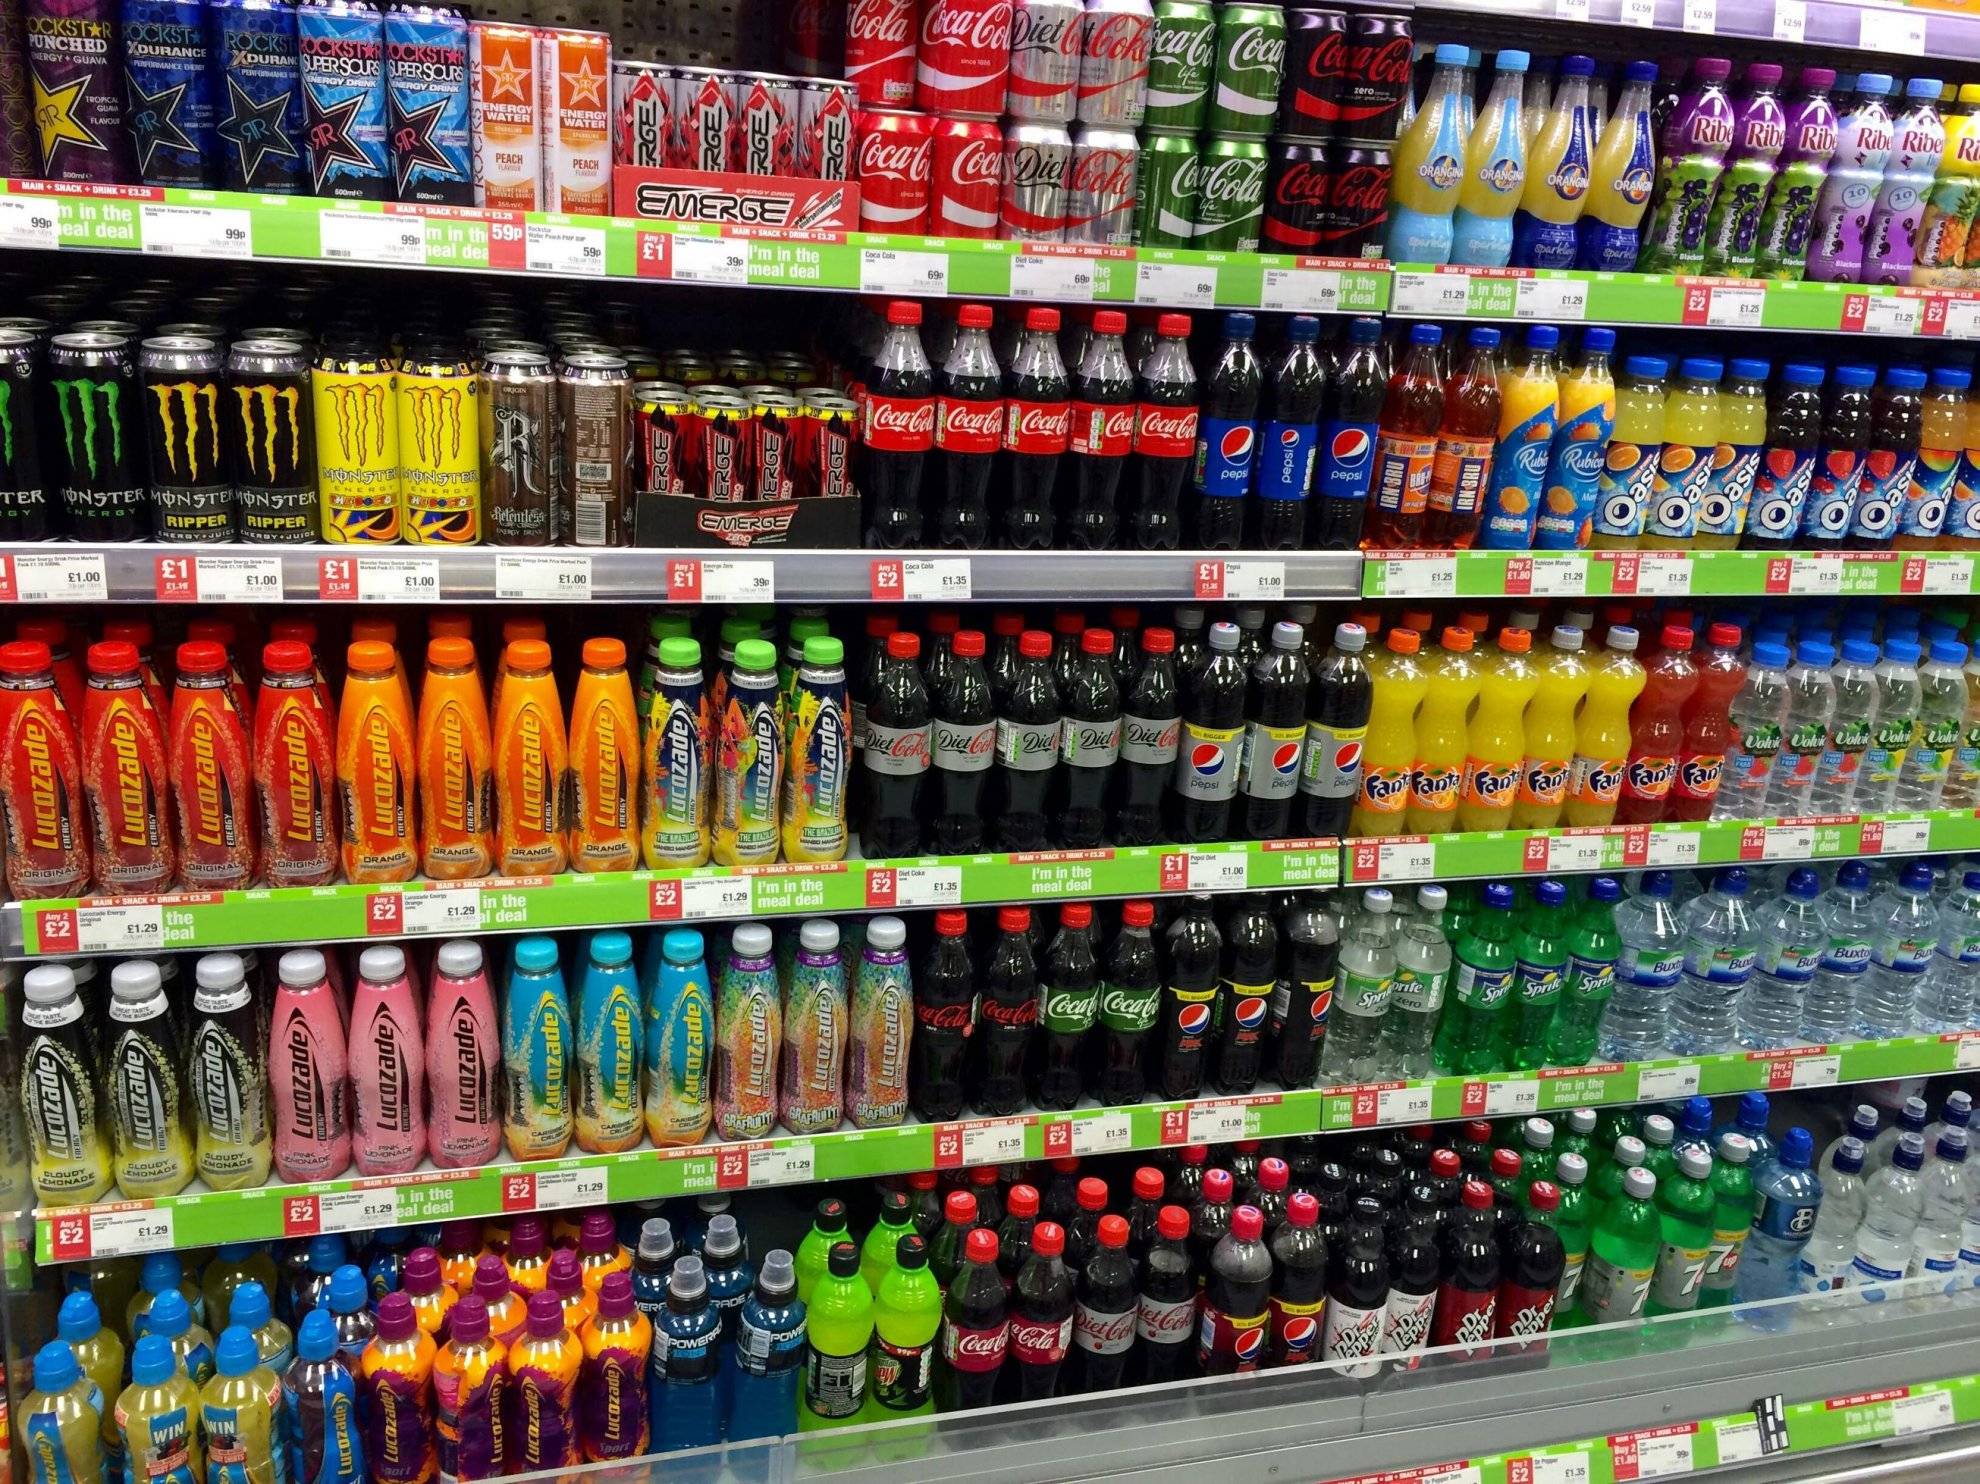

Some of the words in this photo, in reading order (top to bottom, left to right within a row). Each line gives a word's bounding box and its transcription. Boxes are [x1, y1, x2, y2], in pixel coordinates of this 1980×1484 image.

[483, 103, 531, 114] ENERGY
[560, 109, 607, 120] ENERGY
[487, 112, 530, 123] WATER
[564, 118, 606, 129] WATER
[495, 153, 523, 165] PEACH
[573, 159, 599, 170] PEACH
[636, 184, 795, 223] EMERGE
[77, 204, 96, 222] in
[101, 206, 132, 222] the
[31, 218, 52, 229] 99p
[85, 222, 134, 240] deal
[225, 228, 246, 240] 99p
[492, 223, 522, 242] 59p
[401, 234, 421, 246] 99p
[583, 248, 601, 259] 59p
[643, 243, 665, 261] £1
[749, 246, 769, 261] I'm
[773, 247, 790, 262] in
[794, 249, 820, 264] the
[726, 256, 744, 268] 39p
[749, 262, 788, 277] meal
[792, 264, 820, 279] deal
[928, 270, 943, 281] 69p
[1074, 274, 1089, 286] 69p
[1197, 283, 1212, 294] 69p
[1321, 288, 1336, 300] 69p
[1443, 290, 1464, 300] £1.29
[1350, 291, 1375, 305] deal
[1562, 296, 1583, 305] £1.29
[1689, 297, 1705, 311] £2
[1740, 303, 1759, 313] £1.25
[1847, 303, 1864, 318] £2
[1895, 313, 1913, 322] £1.25
[1281, 445, 1293, 483] pepsi
[166, 515, 227, 528] RIPPER
[247, 515, 307, 528] RIPPER
[160, 560, 188, 580] £1
[324, 560, 350, 580] £1
[1200, 564, 1218, 581] £1
[1432, 572, 1452, 581] £1.25
[1563, 572, 1583, 581] £1.29
[1617, 567, 1634, 581] £2
[1668, 572, 1688, 581] £1.35
[1771, 567, 1786, 581] £2
[1820, 572, 1838, 581] £1.35
[1862, 566, 1878, 578] the
[1951, 572, 1969, 581] £1.35
[68, 572, 100, 584] £1.00
[246, 576, 277, 587] £1.00
[405, 576, 435, 587] £1.00
[558, 574, 587, 585] £1.00
[674, 571, 694, 588] £1
[753, 577, 769, 588] 39p
[877, 572, 898, 588] £2
[942, 576, 967, 587] £1.35
[1259, 577, 1280, 587] £1.00
[1854, 579, 1876, 590] deal
[439, 714, 465, 832] Lucozade
[666, 718, 689, 823] Lucozade
[813, 715, 837, 819] Lucozade
[286, 720, 312, 843] Lucozade
[369, 713, 395, 837] Lucozade
[22, 721, 59, 850] Lucozade
[1191, 778, 1219, 790] pepsi
[1821, 829, 1840, 841] the
[511, 846, 554, 856] ORANGE
[1578, 848, 1598, 857] £1.35
[1628, 840, 1644, 855] £2
[1677, 844, 1695, 853] £1.35
[363, 852, 408, 864] ORANGE
[1165, 855, 1184, 871] £1
[1357, 854, 1374, 868] £2
[1410, 856, 1431, 866] £1.35
[1032, 867, 1049, 880] I'm
[1053, 866, 1069, 880] in
[1072, 864, 1092, 879] the
[1222, 866, 1244, 876] £1.00
[758, 881, 775, 894] I'm
[779, 880, 796, 892] in
[800, 879, 823, 892] the
[872, 877, 891, 894] £2
[933, 881, 957, 892] £1.35
[1032, 880, 1064, 894] meal
[1067, 878, 1092, 892] deal
[655, 891, 676, 905] £2
[722, 891, 748, 902] £1.29
[758, 893, 792, 907] meal
[795, 892, 823, 905] deal
[373, 903, 396, 920] £2
[447, 906, 475, 917] £1.29
[166, 911, 194, 928] the
[45, 921, 71, 937] £2
[127, 923, 158, 934] £1.29
[811, 998, 833, 1091] Lucozade
[682, 1002, 701, 1105] Lucozade
[543, 1013, 559, 1116] Lucozade
[374, 1021, 398, 1132] Lucozade
[287, 1033, 314, 1139] Lucozade
[1555, 1080, 1571, 1092] I'm
[1575, 1080, 1587, 1090] in
[1590, 1078, 1604, 1090] the
[123, 1050, 152, 1152] Lucozade
[1466, 1091, 1482, 1103] £2
[1516, 1093, 1534, 1101] £1.35
[1555, 1091, 1577, 1102] meal
[1581, 1090, 1604, 1101] deal
[36, 1056, 70, 1160] Lucozade
[1357, 1101, 1373, 1113] £2
[1409, 1101, 1428, 1109] £1.35
[1166, 1113, 1183, 1127] £1
[1221, 1118, 1242, 1128] £1.00
[1049, 1131, 1067, 1146] £2
[1106, 1127, 1128, 1138] £1.35
[939, 1141, 957, 1157] £2
[998, 1138, 1021, 1149] £1.35
[293, 1152, 316, 1161] PINK
[723, 1162, 742, 1176] £2
[786, 1160, 810, 1170] £1.29
[43, 1168, 86, 1180] CLOUDY
[42, 1173, 96, 1190] LEMONADE
[577, 1183, 603, 1193] £1.29
[508, 1183, 530, 1199] £2
[364, 1204, 392, 1216] £1.29
[423, 1200, 454, 1215] deal
[290, 1207, 314, 1222] £2
[59, 1229, 85, 1245] £2
[138, 1226, 168, 1237] £1.29
[609, 1375, 621, 1440] Lucozade
[153, 1422, 185, 1443] WIN
[205, 1420, 235, 1434] WIN
[383, 1392, 400, 1463] Lucozade
[526, 1390, 541, 1464] Lucozade
[337, 1405, 354, 1476] Lucozade
[1511, 1468, 1530, 1483] £2
[1565, 1466, 1586, 1477] £1.35
